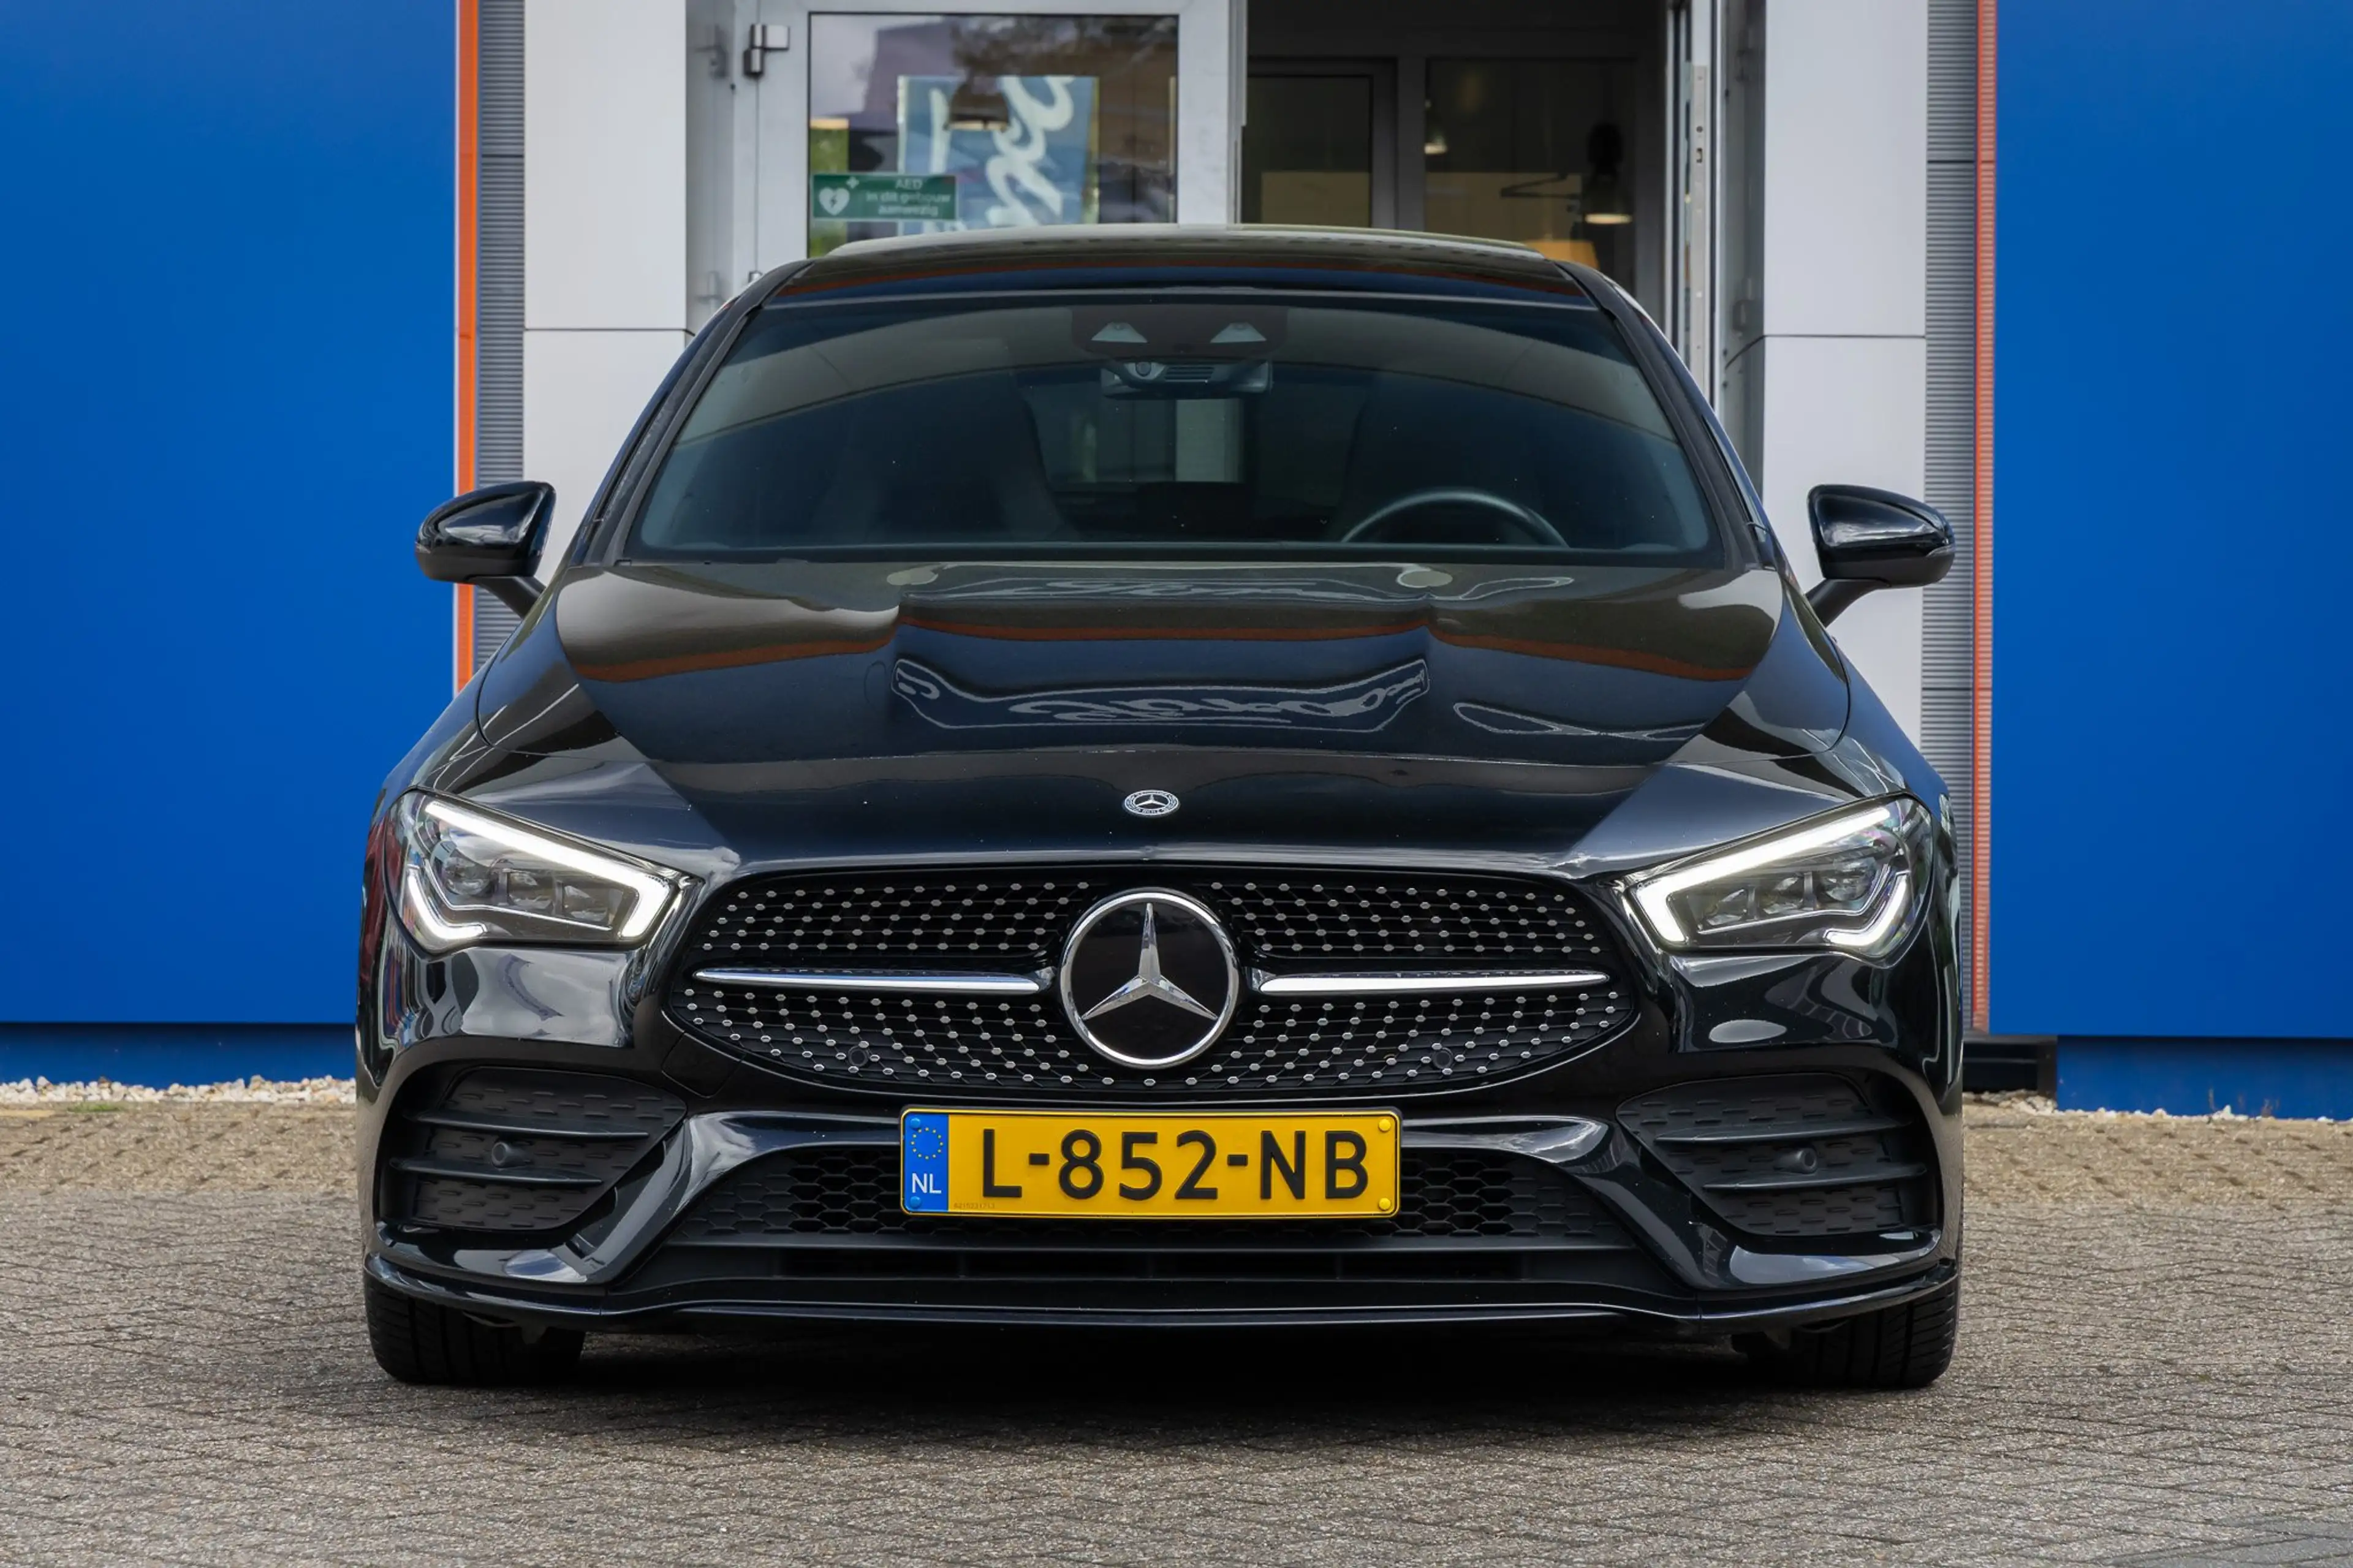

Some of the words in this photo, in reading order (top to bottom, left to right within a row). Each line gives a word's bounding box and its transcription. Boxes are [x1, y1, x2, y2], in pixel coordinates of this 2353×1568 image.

[895, 178, 923, 189] AED
[881, 191, 898, 202] dit
[900, 191, 951, 205] gebouw
[983, 1129, 1368, 1199] L-852-NB
[912, 1172, 942, 1194] NL
